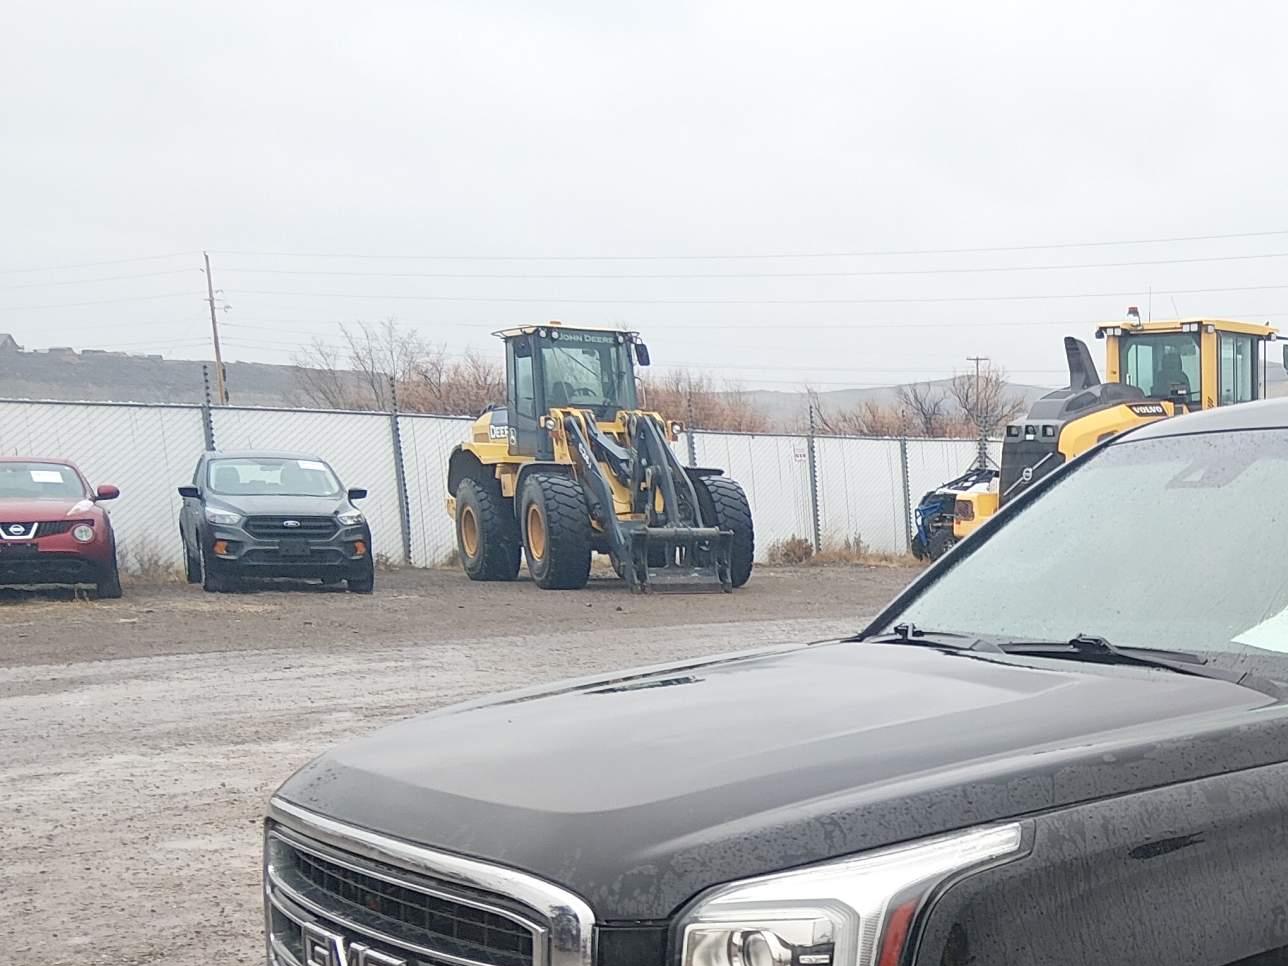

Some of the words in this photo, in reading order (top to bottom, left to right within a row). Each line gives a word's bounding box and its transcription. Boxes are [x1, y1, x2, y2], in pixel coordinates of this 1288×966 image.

[559, 332, 582, 343] JOHN
[584, 334, 615, 344] DEERE
[1132, 405, 1163, 414] VOLVO
